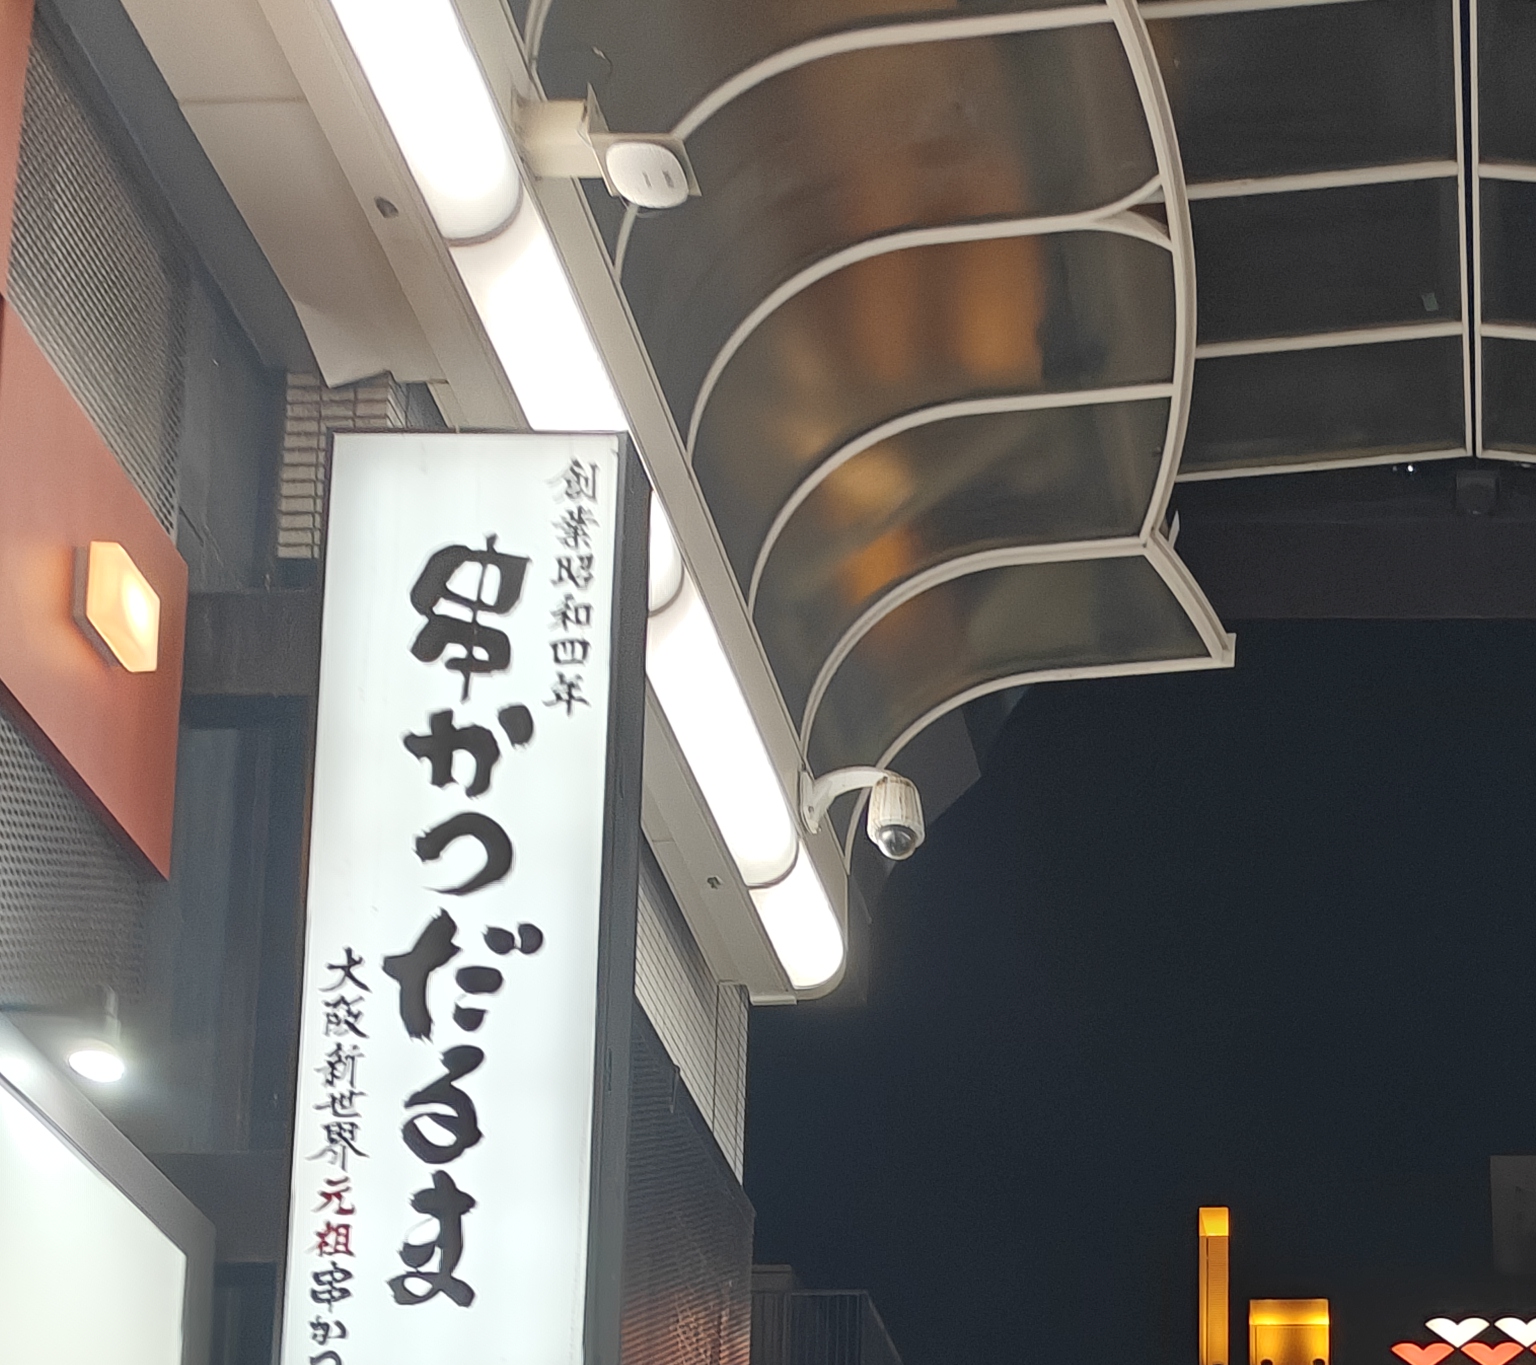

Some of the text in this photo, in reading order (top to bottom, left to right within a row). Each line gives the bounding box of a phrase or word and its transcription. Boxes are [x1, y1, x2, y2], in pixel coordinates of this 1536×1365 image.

[543, 458, 600, 717] 創業昭和四年
[382, 534, 546, 1308] 串かつだるま
